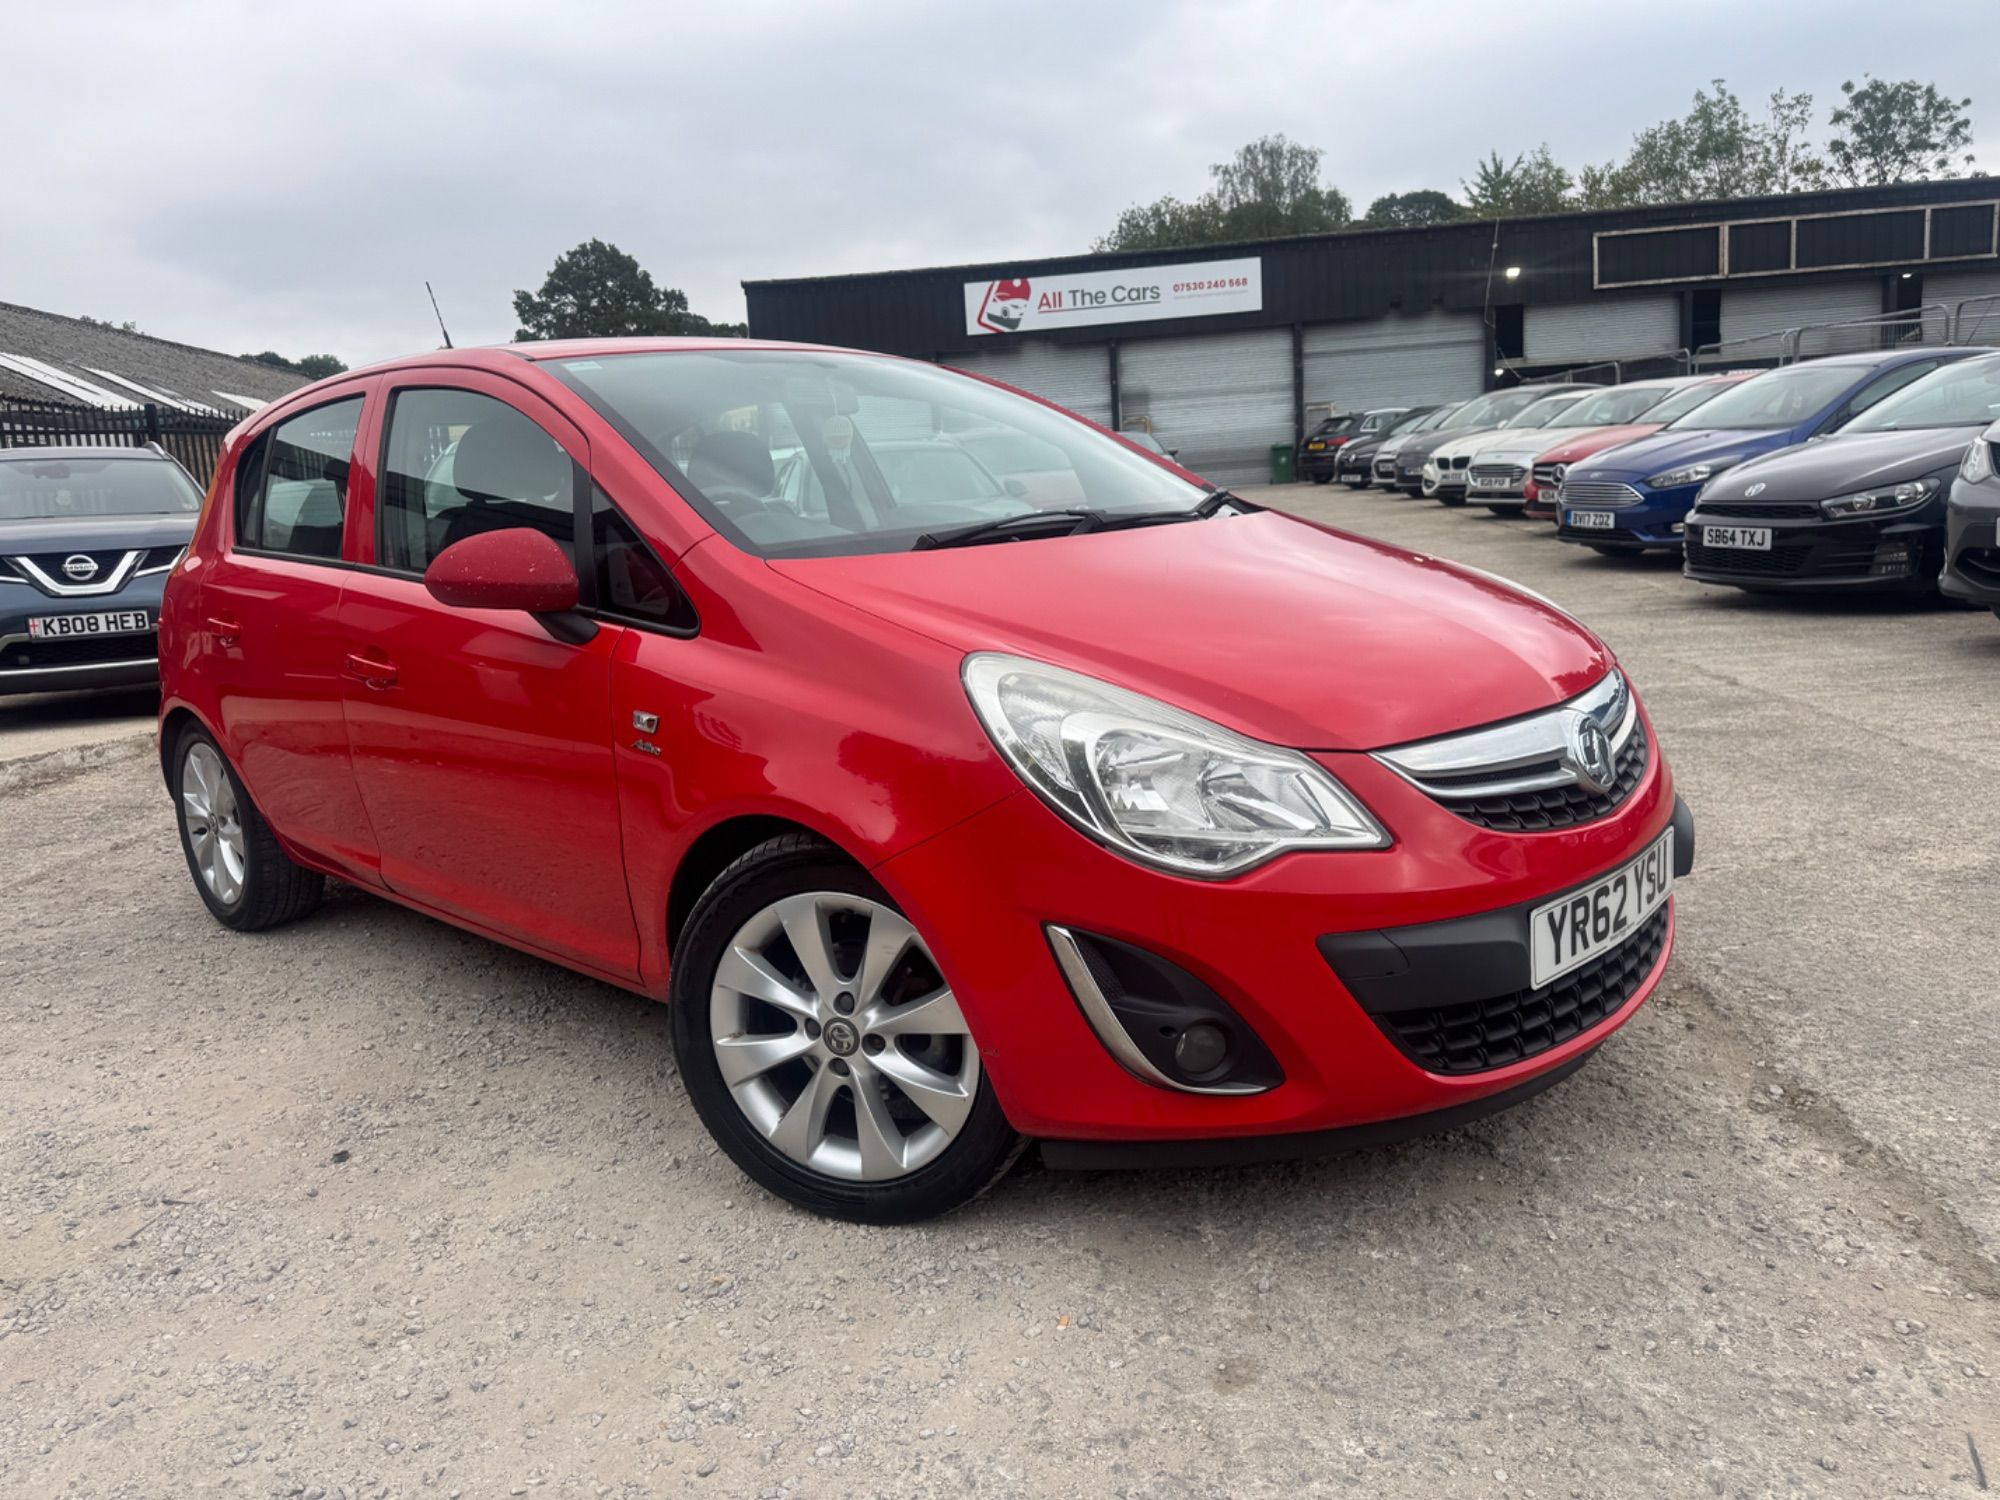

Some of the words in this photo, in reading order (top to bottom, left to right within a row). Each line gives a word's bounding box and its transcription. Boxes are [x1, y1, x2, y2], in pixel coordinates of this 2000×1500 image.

[1038, 291, 1062, 310] All
[1068, 288, 1106, 307] The
[1111, 285, 1161, 303] Cars
[1173, 281, 1205, 293] 07530
[1206, 279, 1226, 289] 240
[1707, 528, 1736, 545] SB64
[1740, 530, 1766, 547] TXJ
[42, 615, 100, 636] KB08
[104, 612, 147, 631] HEB
[1547, 873, 1627, 966] YR62
[1634, 839, 1668, 914] YSU
